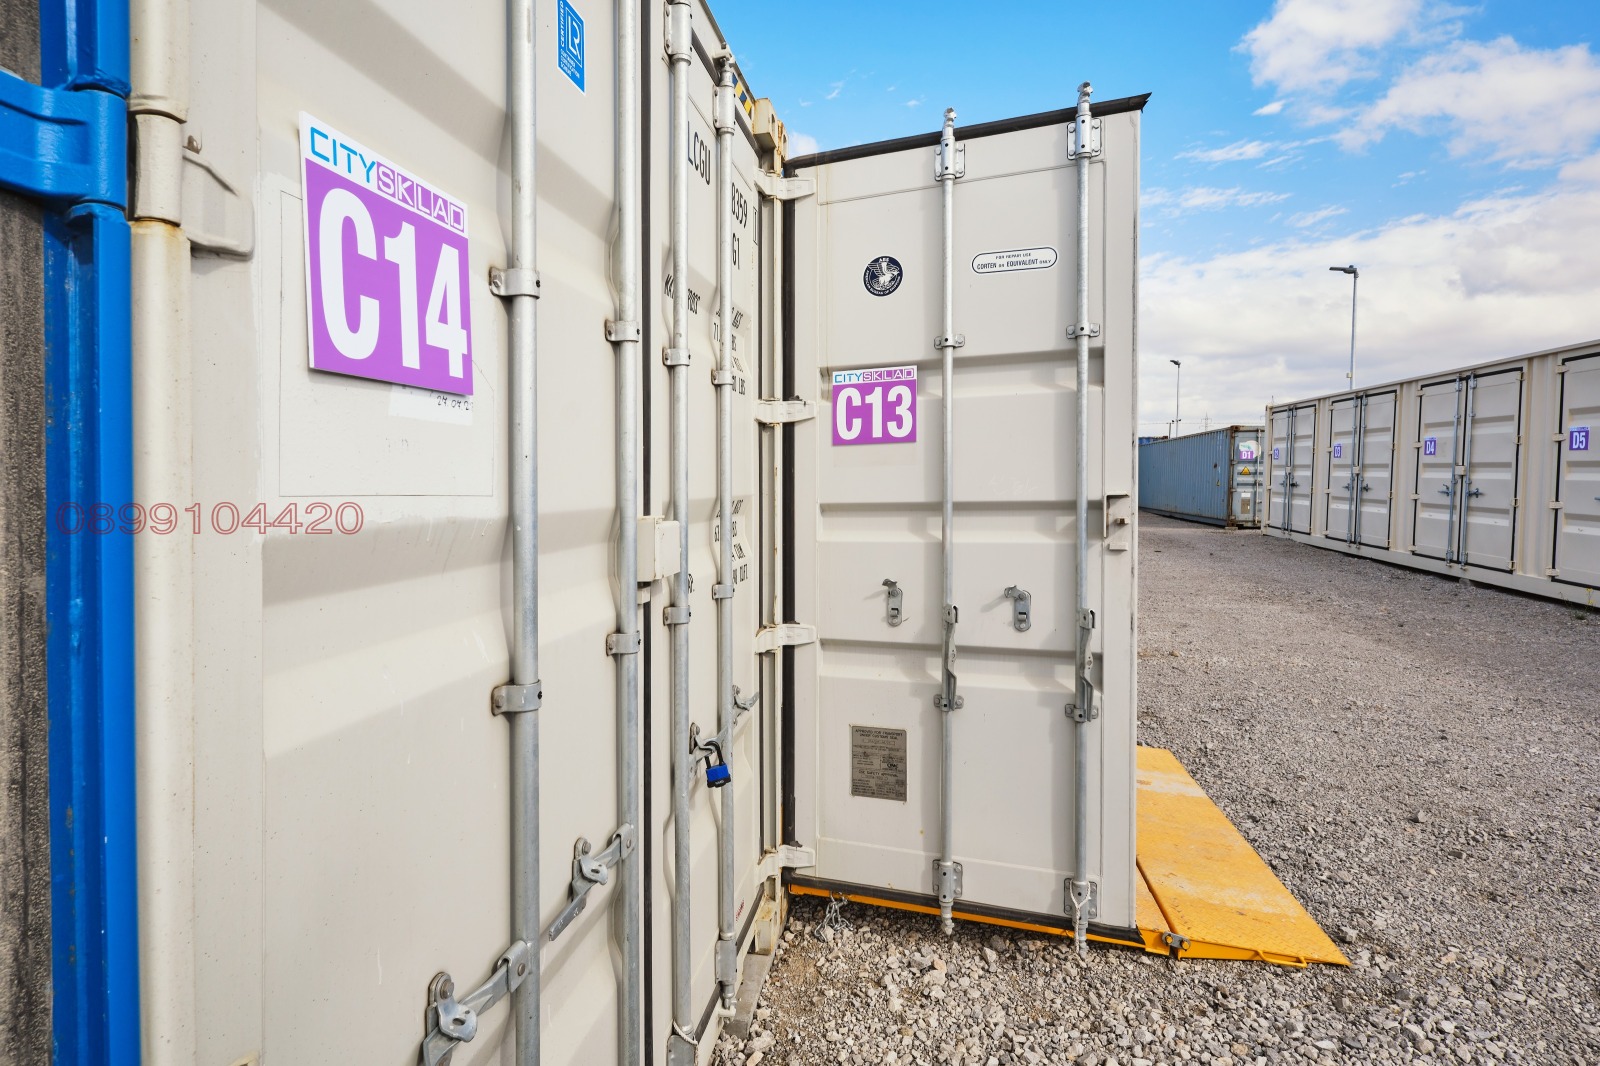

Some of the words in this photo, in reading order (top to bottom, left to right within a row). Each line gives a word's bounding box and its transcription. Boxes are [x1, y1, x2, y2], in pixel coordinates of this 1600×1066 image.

[687, 120, 711, 186] LCGU
[310, 126, 466, 231] CITYSKLAD
[977, 262, 997, 270] CORTEN
[1007, 259, 1039, 268] EQUIVALENT
[318, 187, 468, 379] C14
[834, 368, 915, 384] CITYSKLAD
[836, 385, 914, 441] C13
[1426, 441, 1435, 454] D4
[1572, 431, 1586, 449] D5
[1241, 451, 1251, 459] D1
